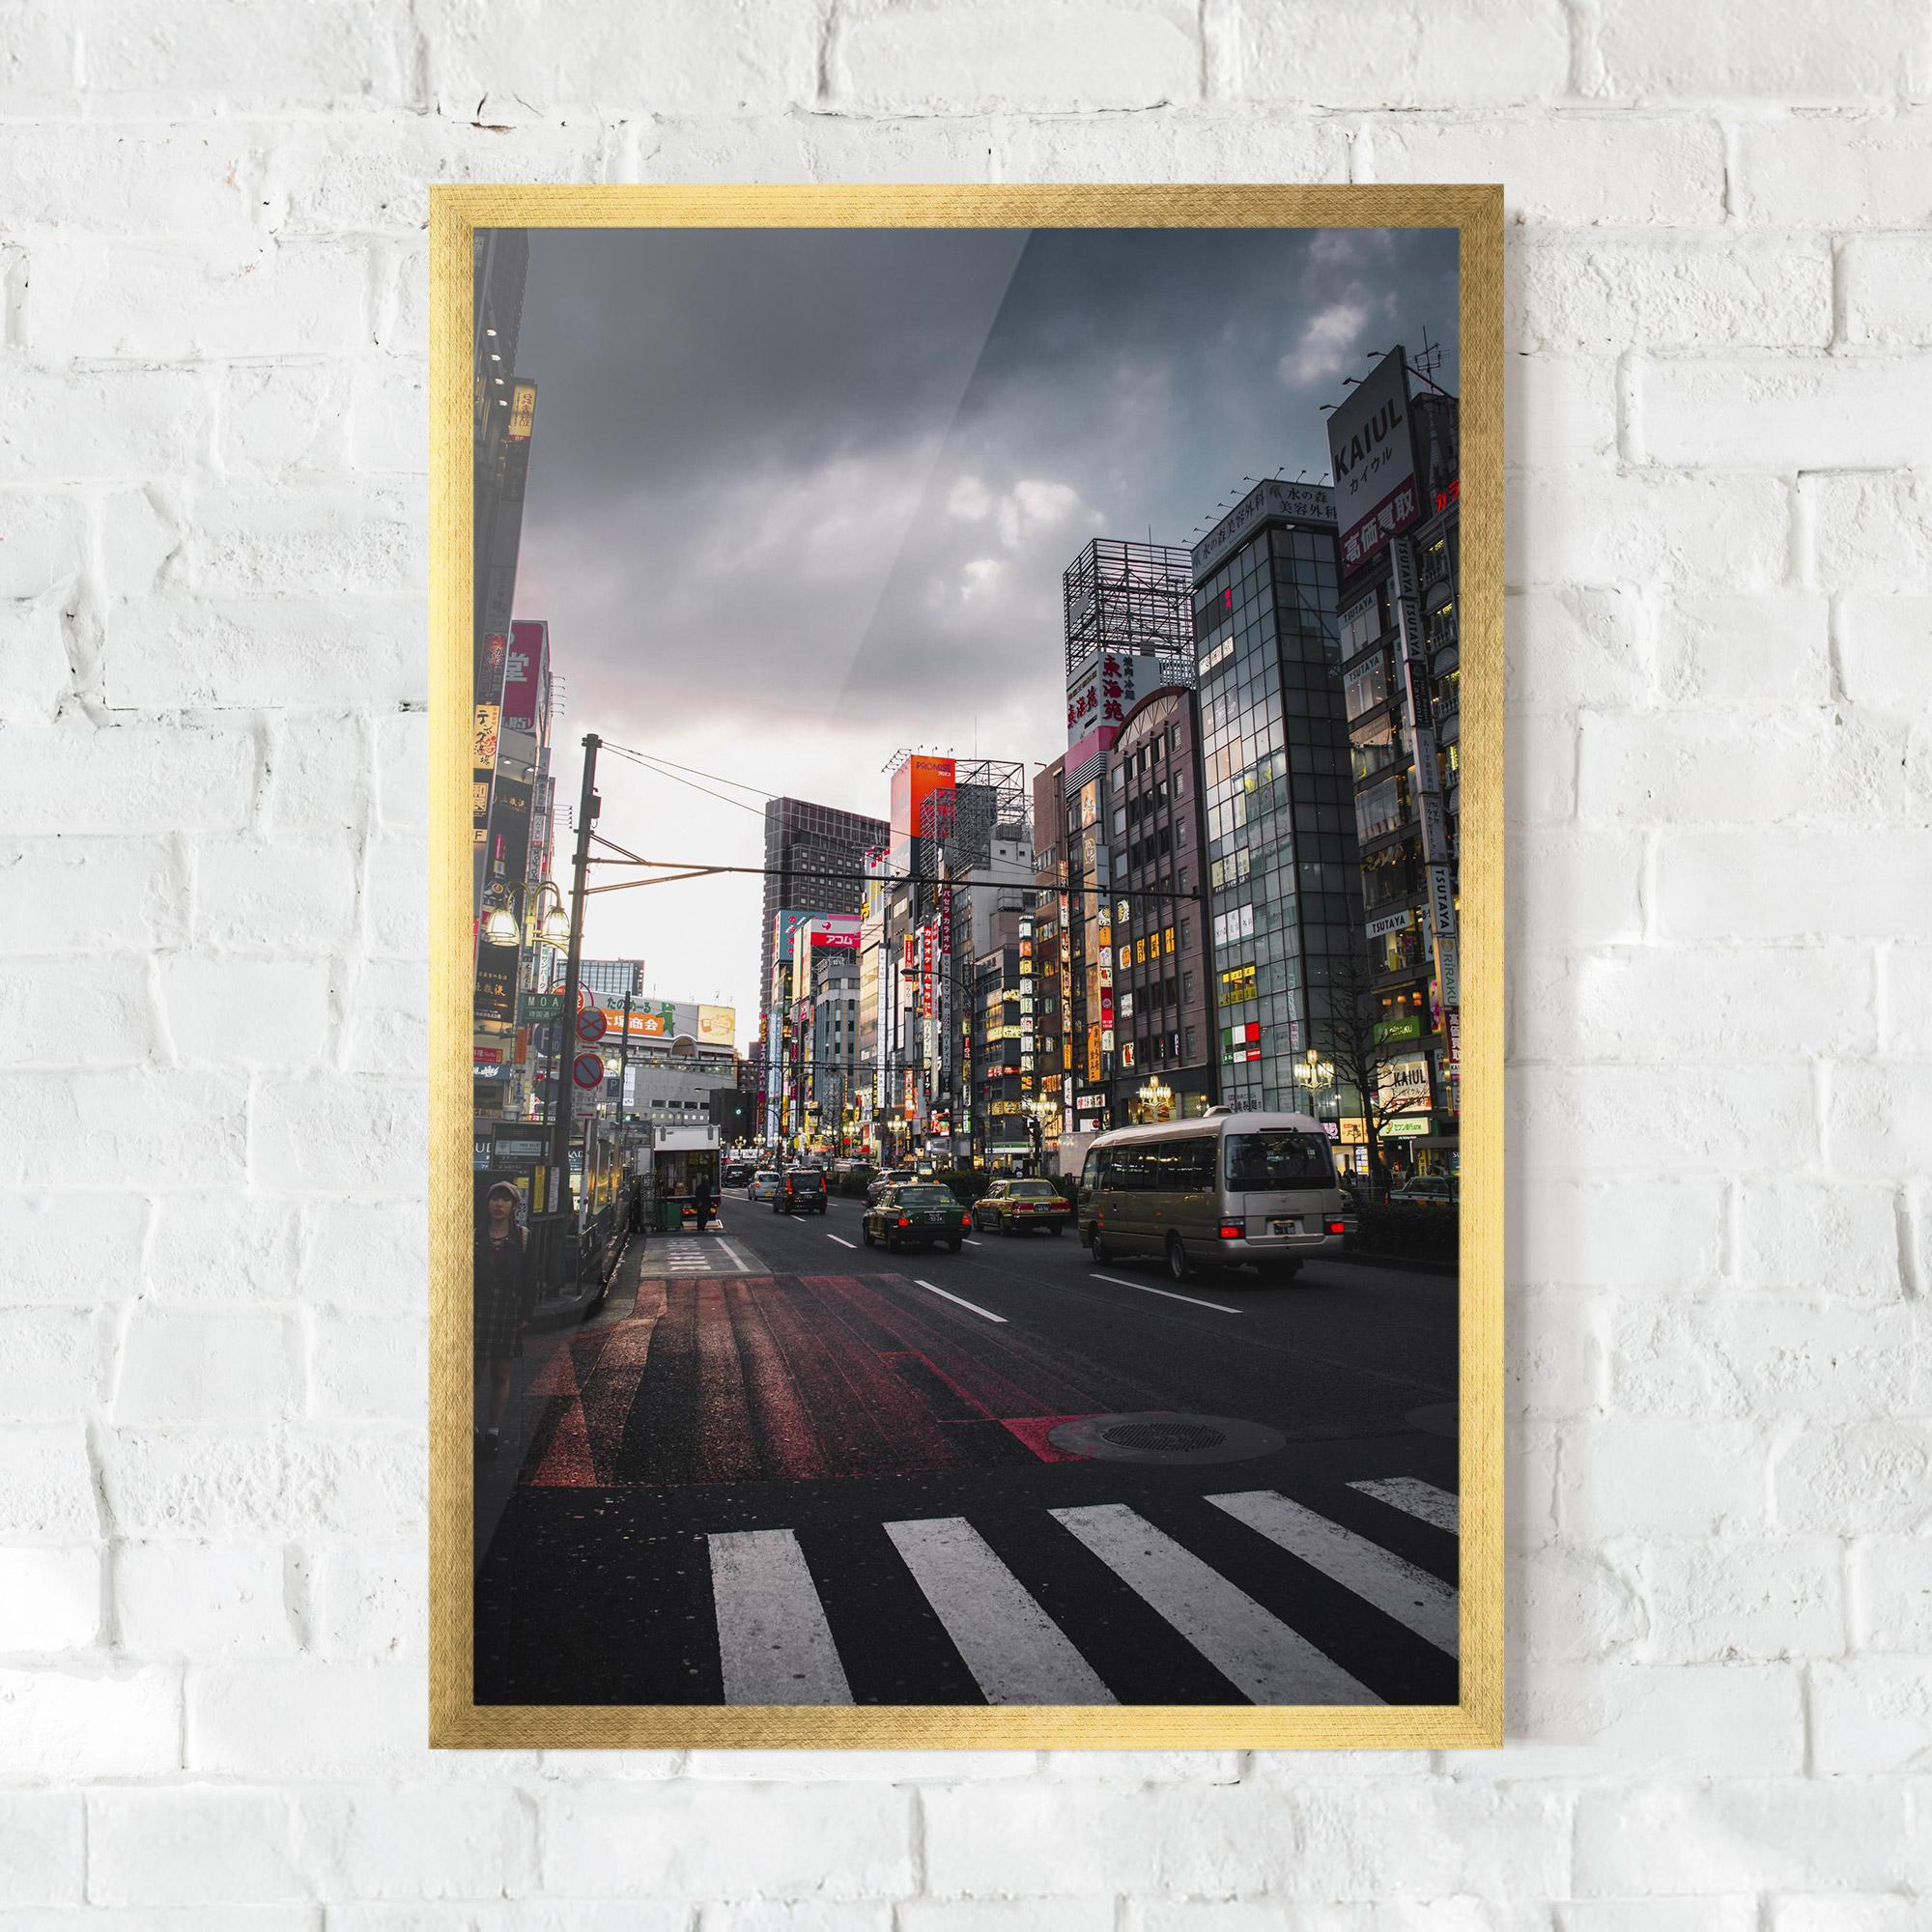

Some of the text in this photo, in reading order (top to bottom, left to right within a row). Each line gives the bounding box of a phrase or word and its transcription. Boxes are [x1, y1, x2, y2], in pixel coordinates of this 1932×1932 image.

[1333, 398, 1403, 483] KAIUL
[1350, 446, 1393, 496] カイウル
[1289, 487, 1328, 504] 水の森
[1281, 500, 1337, 520] 美容外科
[1344, 488, 1414, 564] 高価買取
[1399, 541, 1412, 594] TSUTAYA
[1345, 595, 1374, 622] TSUTAYA
[1406, 604, 1419, 657] TSUTAYA
[1350, 655, 1381, 680] TSUTAYA
[1102, 654, 1125, 722] 東海苑
[916, 761, 952, 772] PROMISE
[1435, 869, 1450, 929] TSUTAYA
[1372, 915, 1406, 933] TSUTAYA
[826, 934, 853, 946] アコム
[610, 1079, 618, 1090] P
[1394, 1069, 1426, 1087] KAIUL
